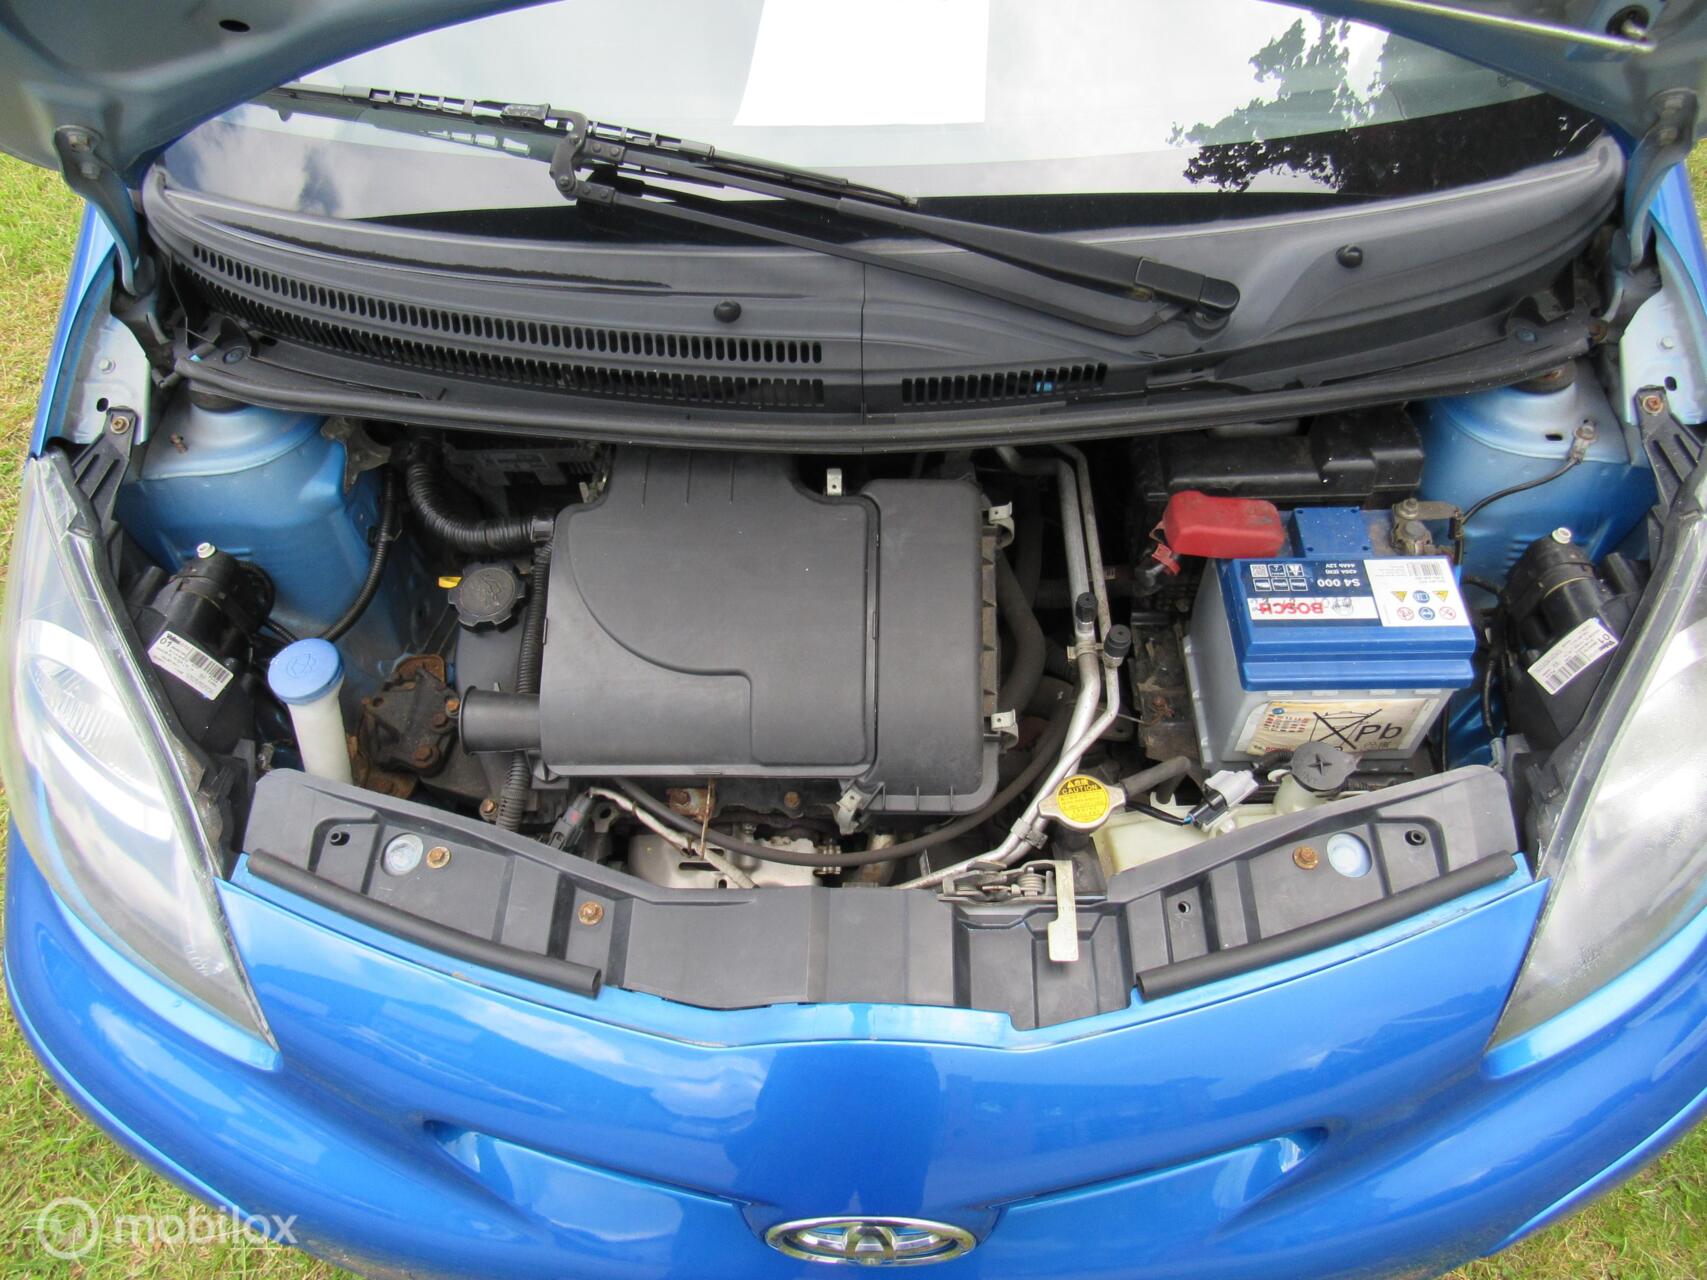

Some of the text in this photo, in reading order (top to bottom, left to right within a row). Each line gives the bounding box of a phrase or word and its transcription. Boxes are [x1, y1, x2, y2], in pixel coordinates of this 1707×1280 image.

[1317, 578, 1360, 587] S4 000
[1259, 602, 1323, 615] BOSCH
[1354, 722, 1402, 742] Pb
[1062, 784, 1097, 794] CAUTION
